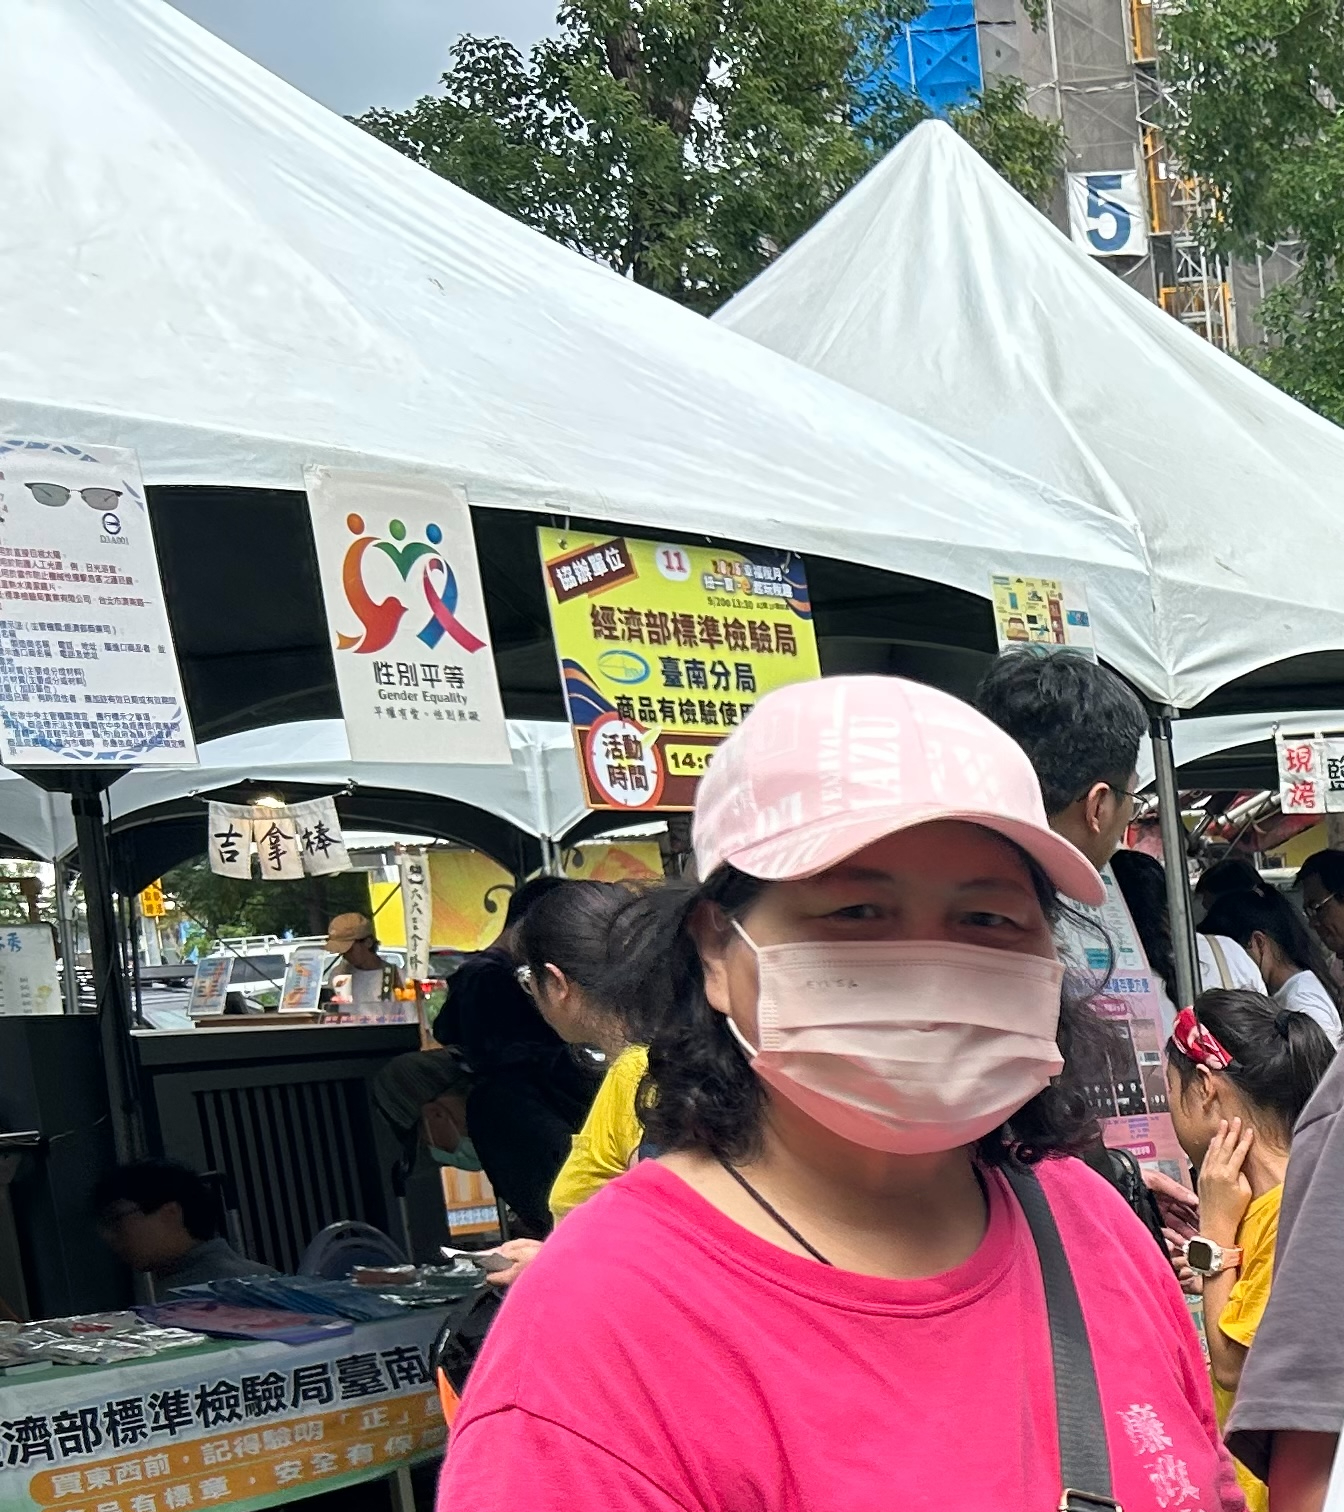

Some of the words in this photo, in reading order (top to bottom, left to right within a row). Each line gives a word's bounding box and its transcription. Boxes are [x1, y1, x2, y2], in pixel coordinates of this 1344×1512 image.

[1086, 175, 1131, 251] 5
[660, 550, 688, 573] 11
[589, 603, 798, 657] 經濟部標準檢驗局
[373, 660, 466, 689] 性別平等
[657, 655, 757, 693] 臺南分局
[378, 688, 419, 702] Gender
[422, 690, 468, 706] Equality
[601, 732, 645, 762] 活動
[606, 763, 649, 792] 時間
[1285, 744, 1317, 809] 現烤
[213, 820, 342, 872] 吉拿棒
[0, 1345, 434, 1472] 濟部標準檢驗局臺南
